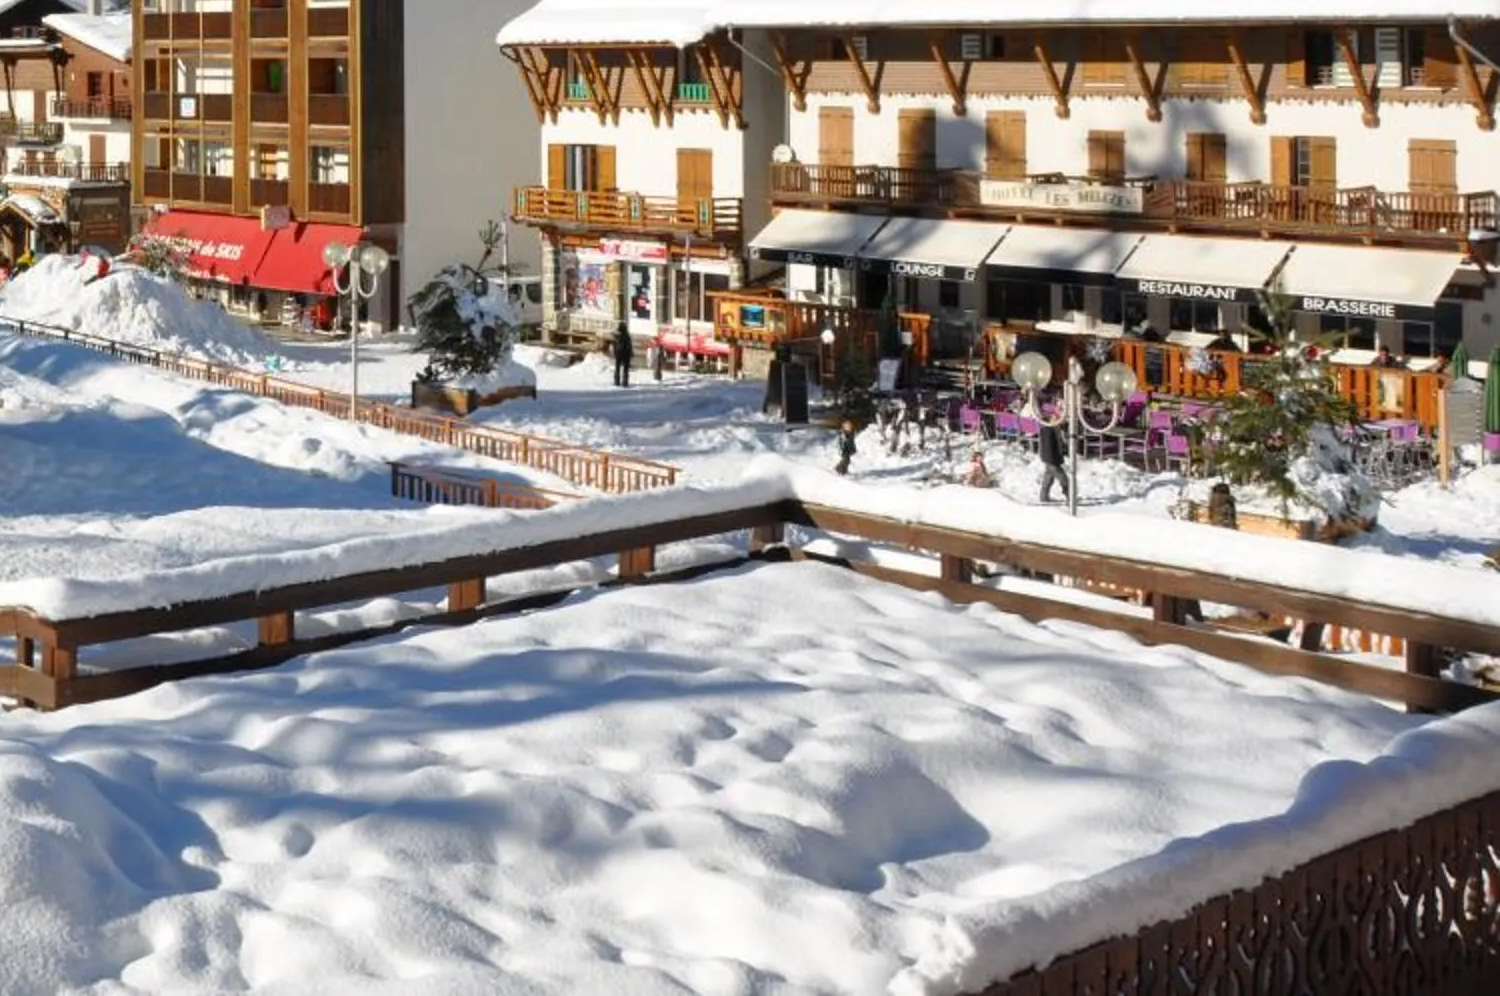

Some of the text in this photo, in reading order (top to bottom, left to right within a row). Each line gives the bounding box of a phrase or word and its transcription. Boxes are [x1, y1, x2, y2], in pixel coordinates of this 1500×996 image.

[891, 261, 944, 278] LOUNGE
[1138, 281, 1237, 301] RESTAURANT
[1303, 297, 1395, 317] BRASSERIE
